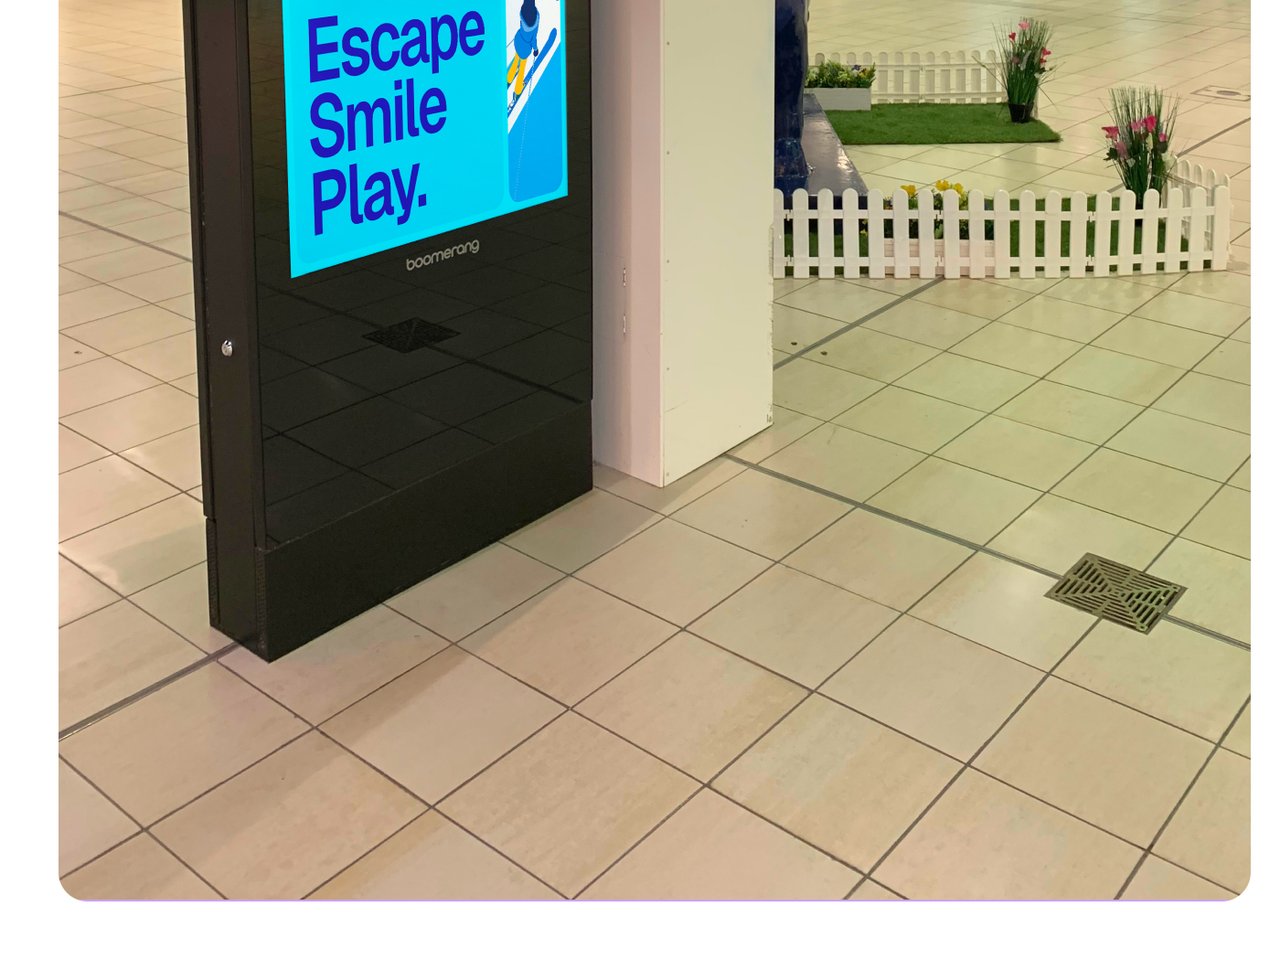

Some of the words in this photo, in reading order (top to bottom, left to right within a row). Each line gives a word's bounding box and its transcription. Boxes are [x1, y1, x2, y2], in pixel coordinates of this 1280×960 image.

[308, 10, 485, 83] Escape
[310, 78, 447, 158] Smile
[312, 163, 427, 236] Play.
[406, 239, 480, 271] boomerang
